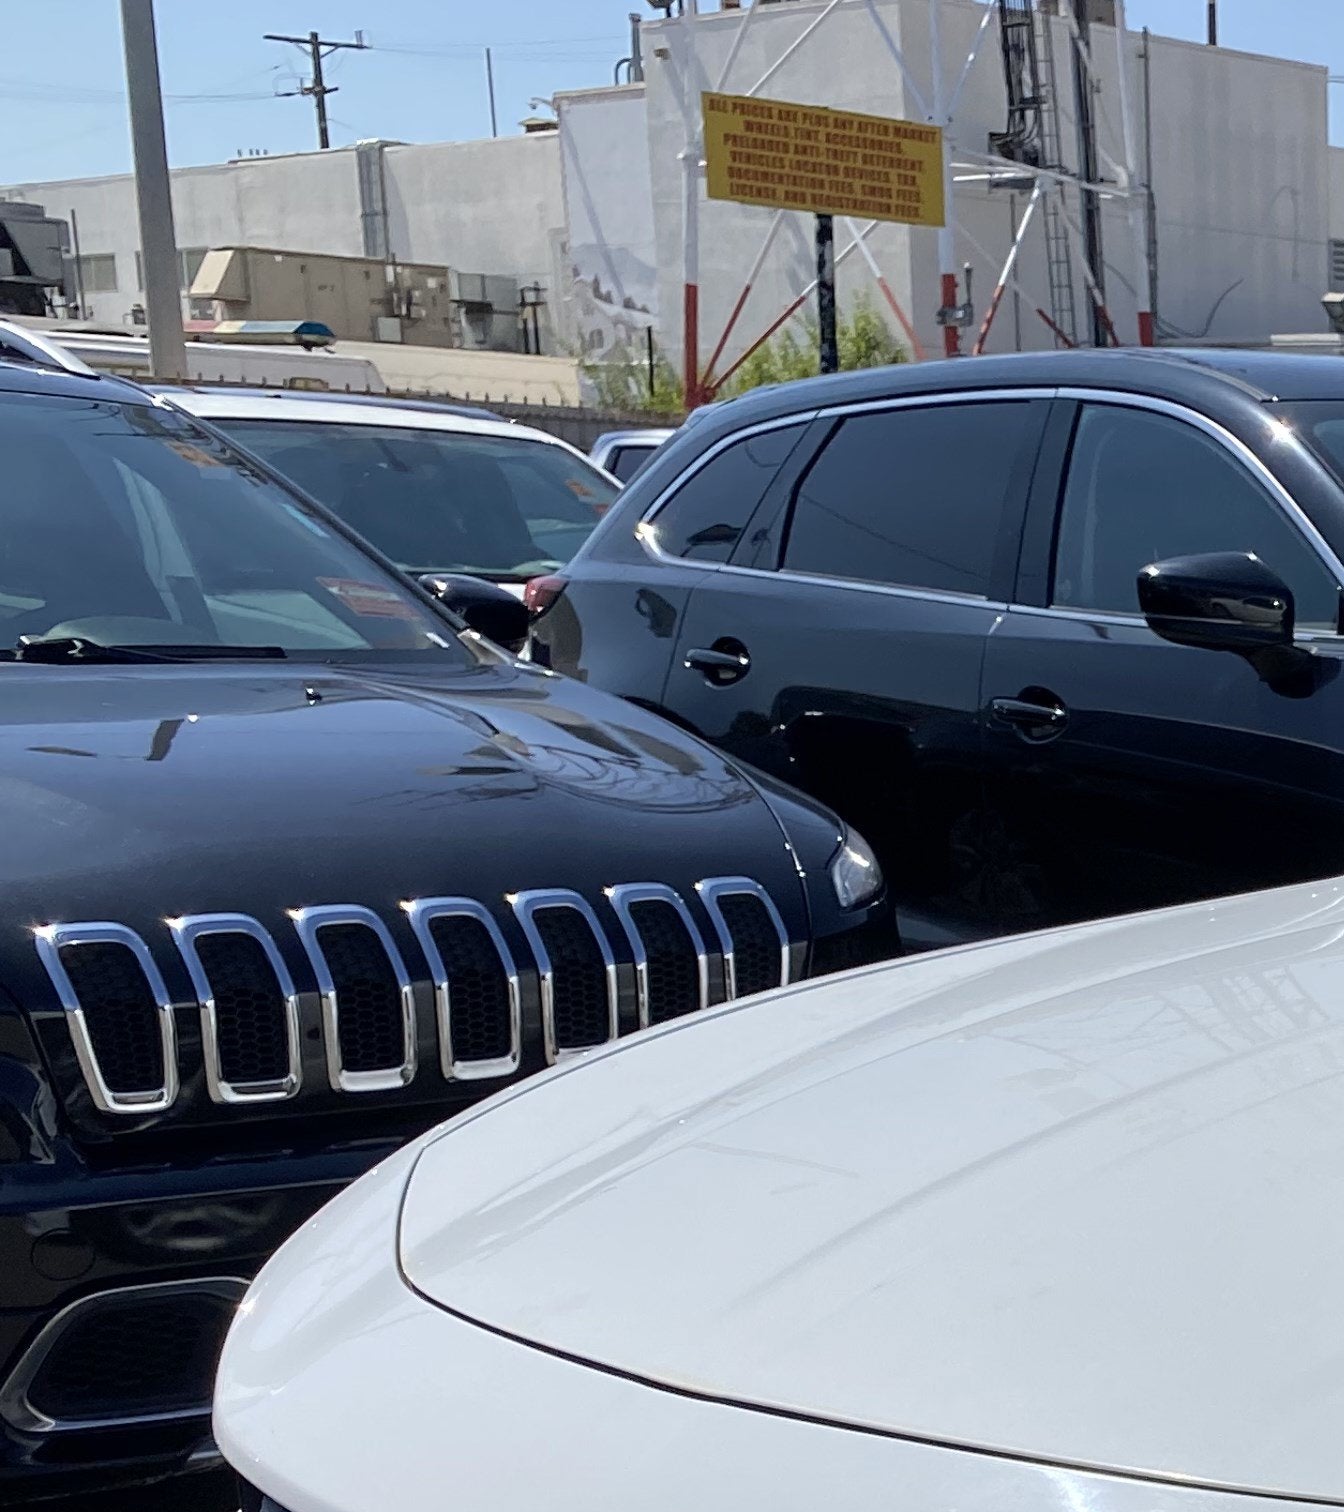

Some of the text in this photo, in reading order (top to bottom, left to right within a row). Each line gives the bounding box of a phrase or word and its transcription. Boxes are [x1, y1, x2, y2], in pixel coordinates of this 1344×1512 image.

[731, 101, 773, 120] PRICES
[802, 112, 829, 128] PLUS
[857, 121, 890, 136] AFTER
[893, 125, 937, 144] MARKET
